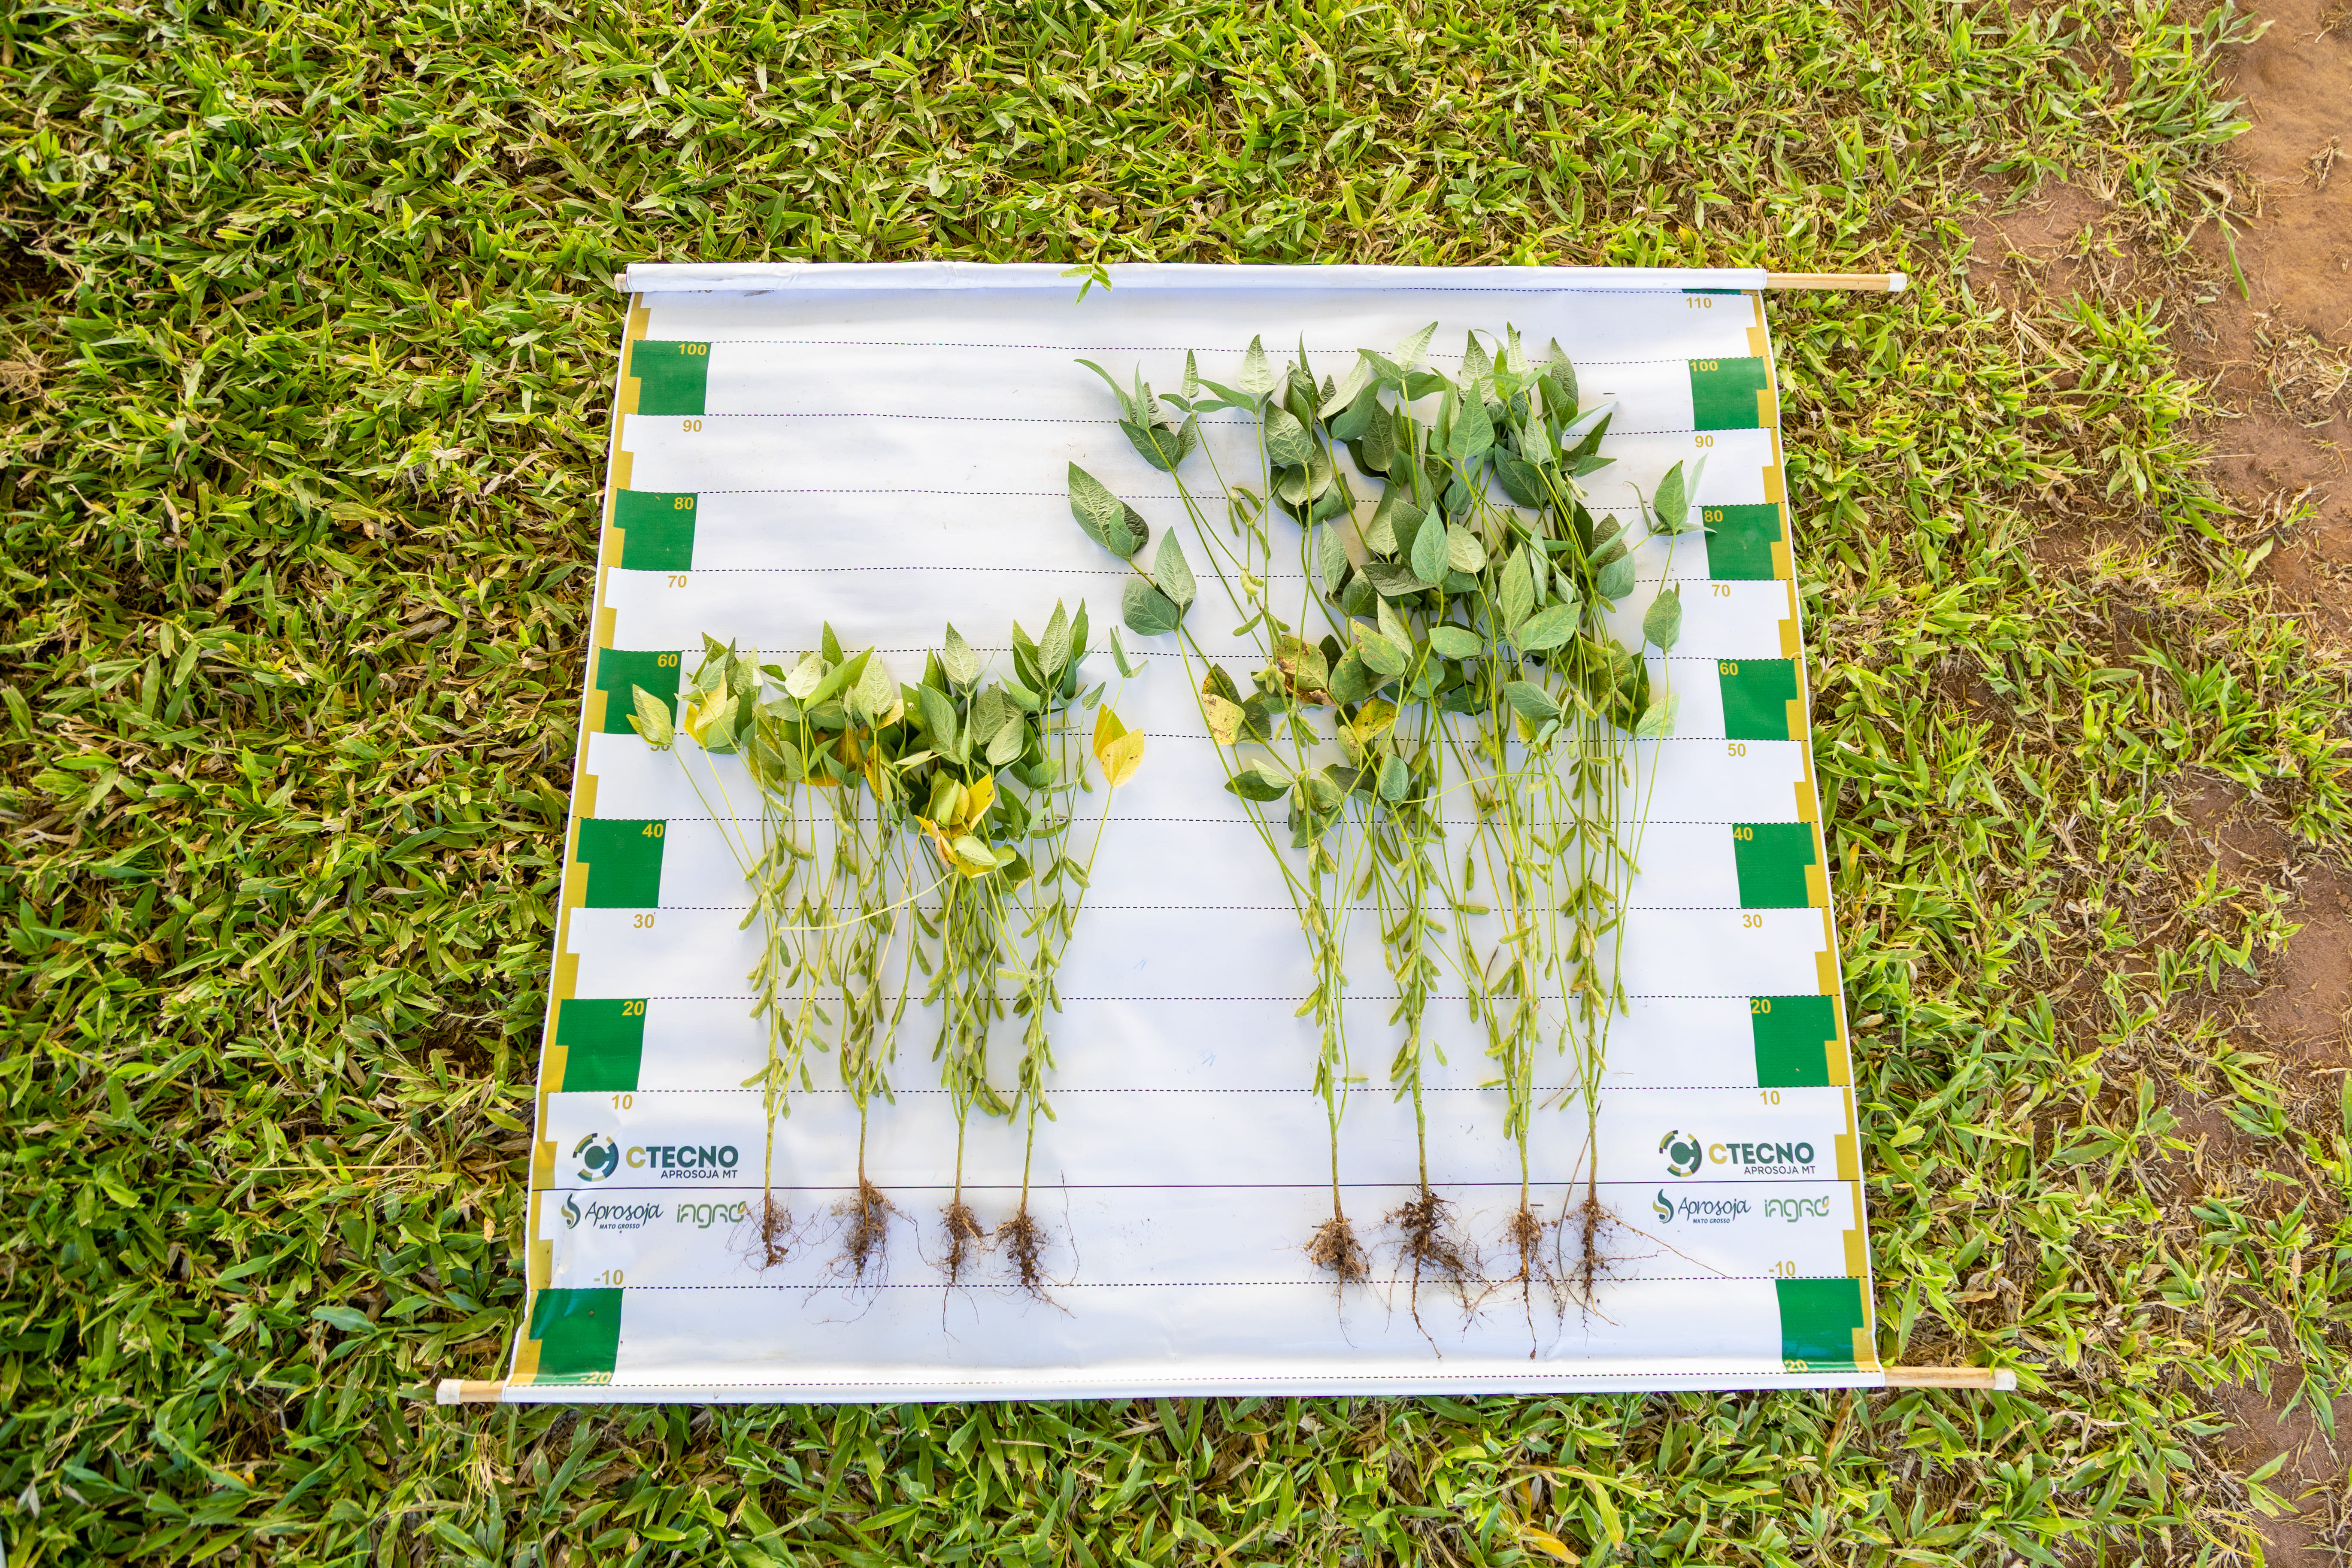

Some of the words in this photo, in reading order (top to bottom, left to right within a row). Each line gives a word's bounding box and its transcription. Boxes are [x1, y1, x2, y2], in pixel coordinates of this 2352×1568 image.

[1686, 297, 1712, 309] 110
[678, 343, 707, 355] 100
[1690, 361, 1718, 372] 100
[683, 419, 702, 432] 90
[1694, 435, 1714, 447] 90
[674, 497, 694, 510] 80
[1704, 510, 1723, 522] 80
[668, 575, 687, 588] 70
[1711, 584, 1731, 597] 70
[658, 654, 678, 667] 60
[1719, 662, 1738, 676] 60
[1728, 743, 1746, 757] 50
[642, 823, 664, 838] 40
[1733, 827, 1753, 841] 40
[633, 914, 655, 928] 30
[1742, 914, 1762, 928] 30
[622, 1001, 644, 1016] 20
[1750, 999, 1771, 1014] 20
[612, 1094, 633, 1110] 10
[1760, 1090, 1780, 1105] 10
[626, 1145, 739, 1168] CTECNO
[1709, 1142, 1814, 1164] CTECNO
[661, 1170, 719, 1179] APROSOJA
[723, 1170, 738, 1179] MT
[1744, 1166, 1799, 1174] APROSOJA
[1803, 1166, 1816, 1174] MT
[585, 1201, 664, 1226] Aprosoja
[1678, 1197, 1751, 1221] Aprosoja
[1768, 1261, 1796, 1277] -10
[594, 1269, 624, 1285] -10
[580, 1371, 612, 1384] -20
